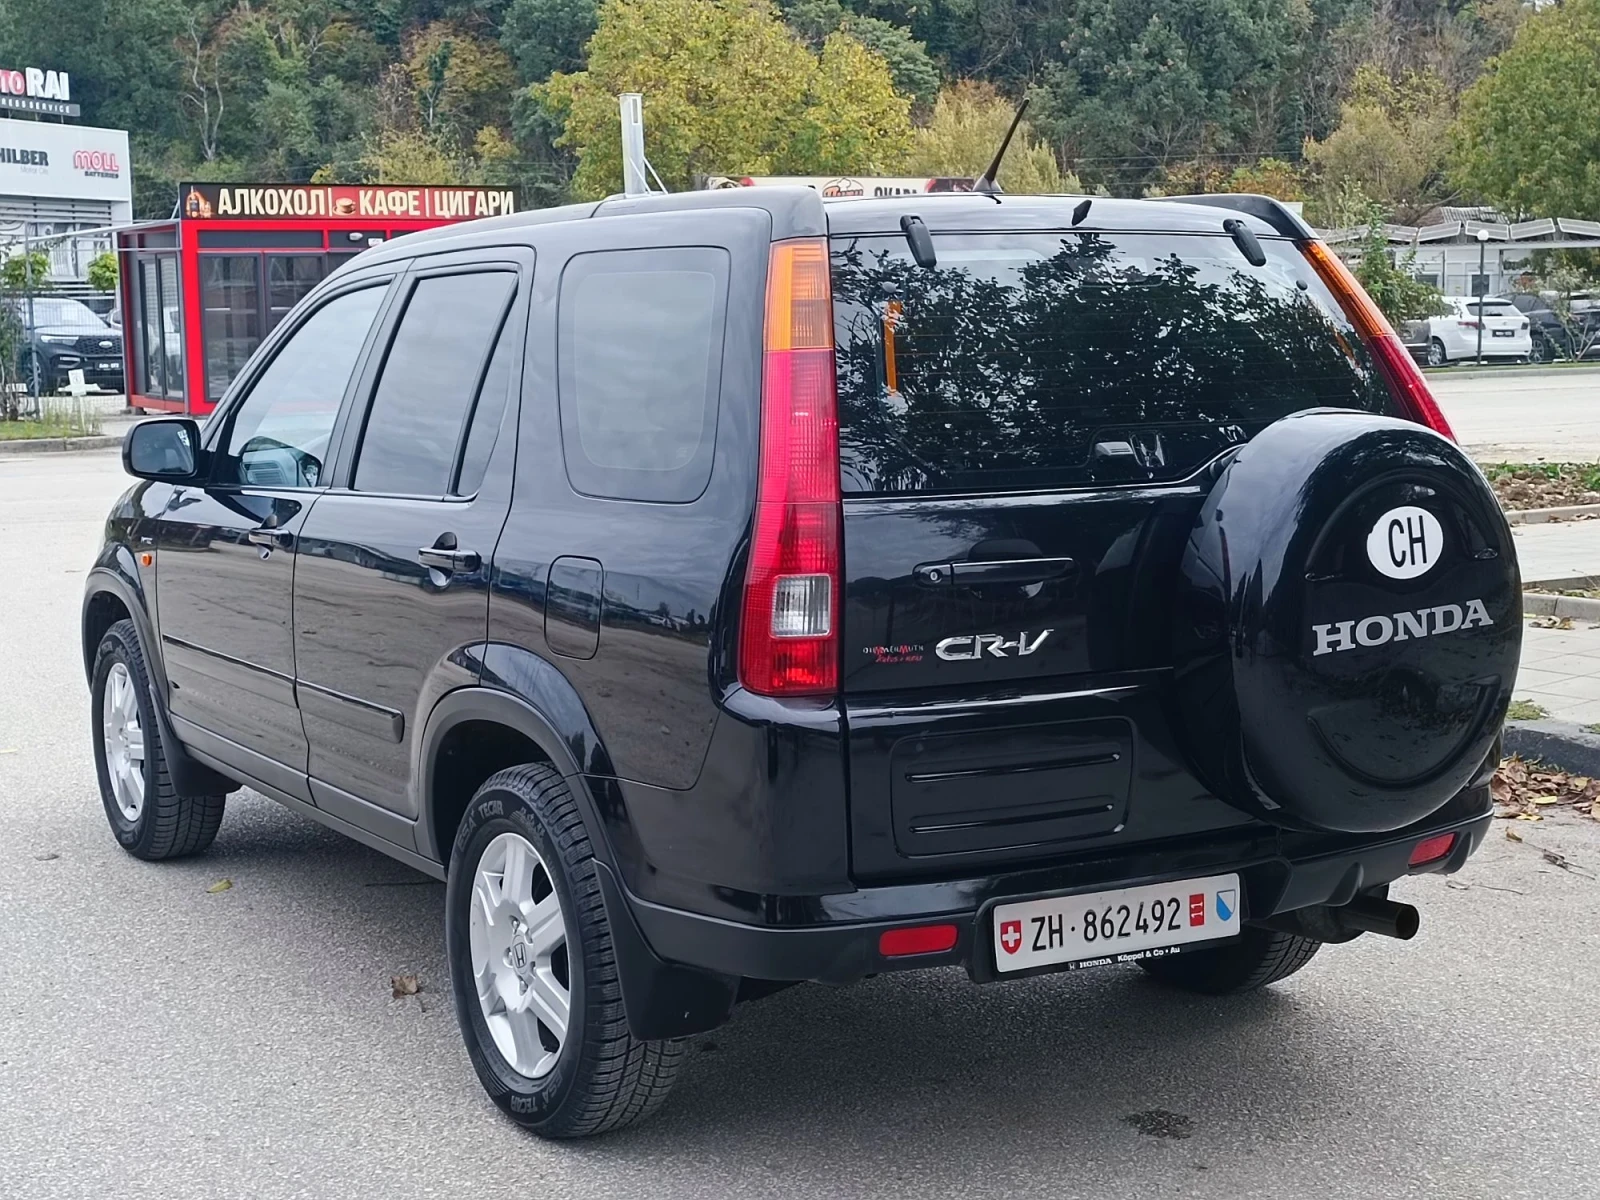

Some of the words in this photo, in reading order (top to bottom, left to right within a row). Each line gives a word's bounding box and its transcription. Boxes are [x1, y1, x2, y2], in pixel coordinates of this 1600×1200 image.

[73, 150, 119, 172] MOLL
[218, 188, 325, 216] АЛКОХОЛ
[359, 190, 420, 216] КАФЕ
[433, 190, 515, 219] ЦИГАРИ
[1388, 515, 1427, 568] CH
[1312, 598, 1494, 656] HONDA
[935, 629, 1055, 661] CR-V
[478, 800, 504, 819] TECAR
[1031, 914, 1064, 951] ZH
[1083, 897, 1181, 943] 862492
[1079, 957, 1113, 969] HONDA
[1117, 950, 1145, 963] Köppel
[1145, 950, 1152, 958] &
[1153, 948, 1164, 956] Co
[1170, 946, 1180, 954] Au
